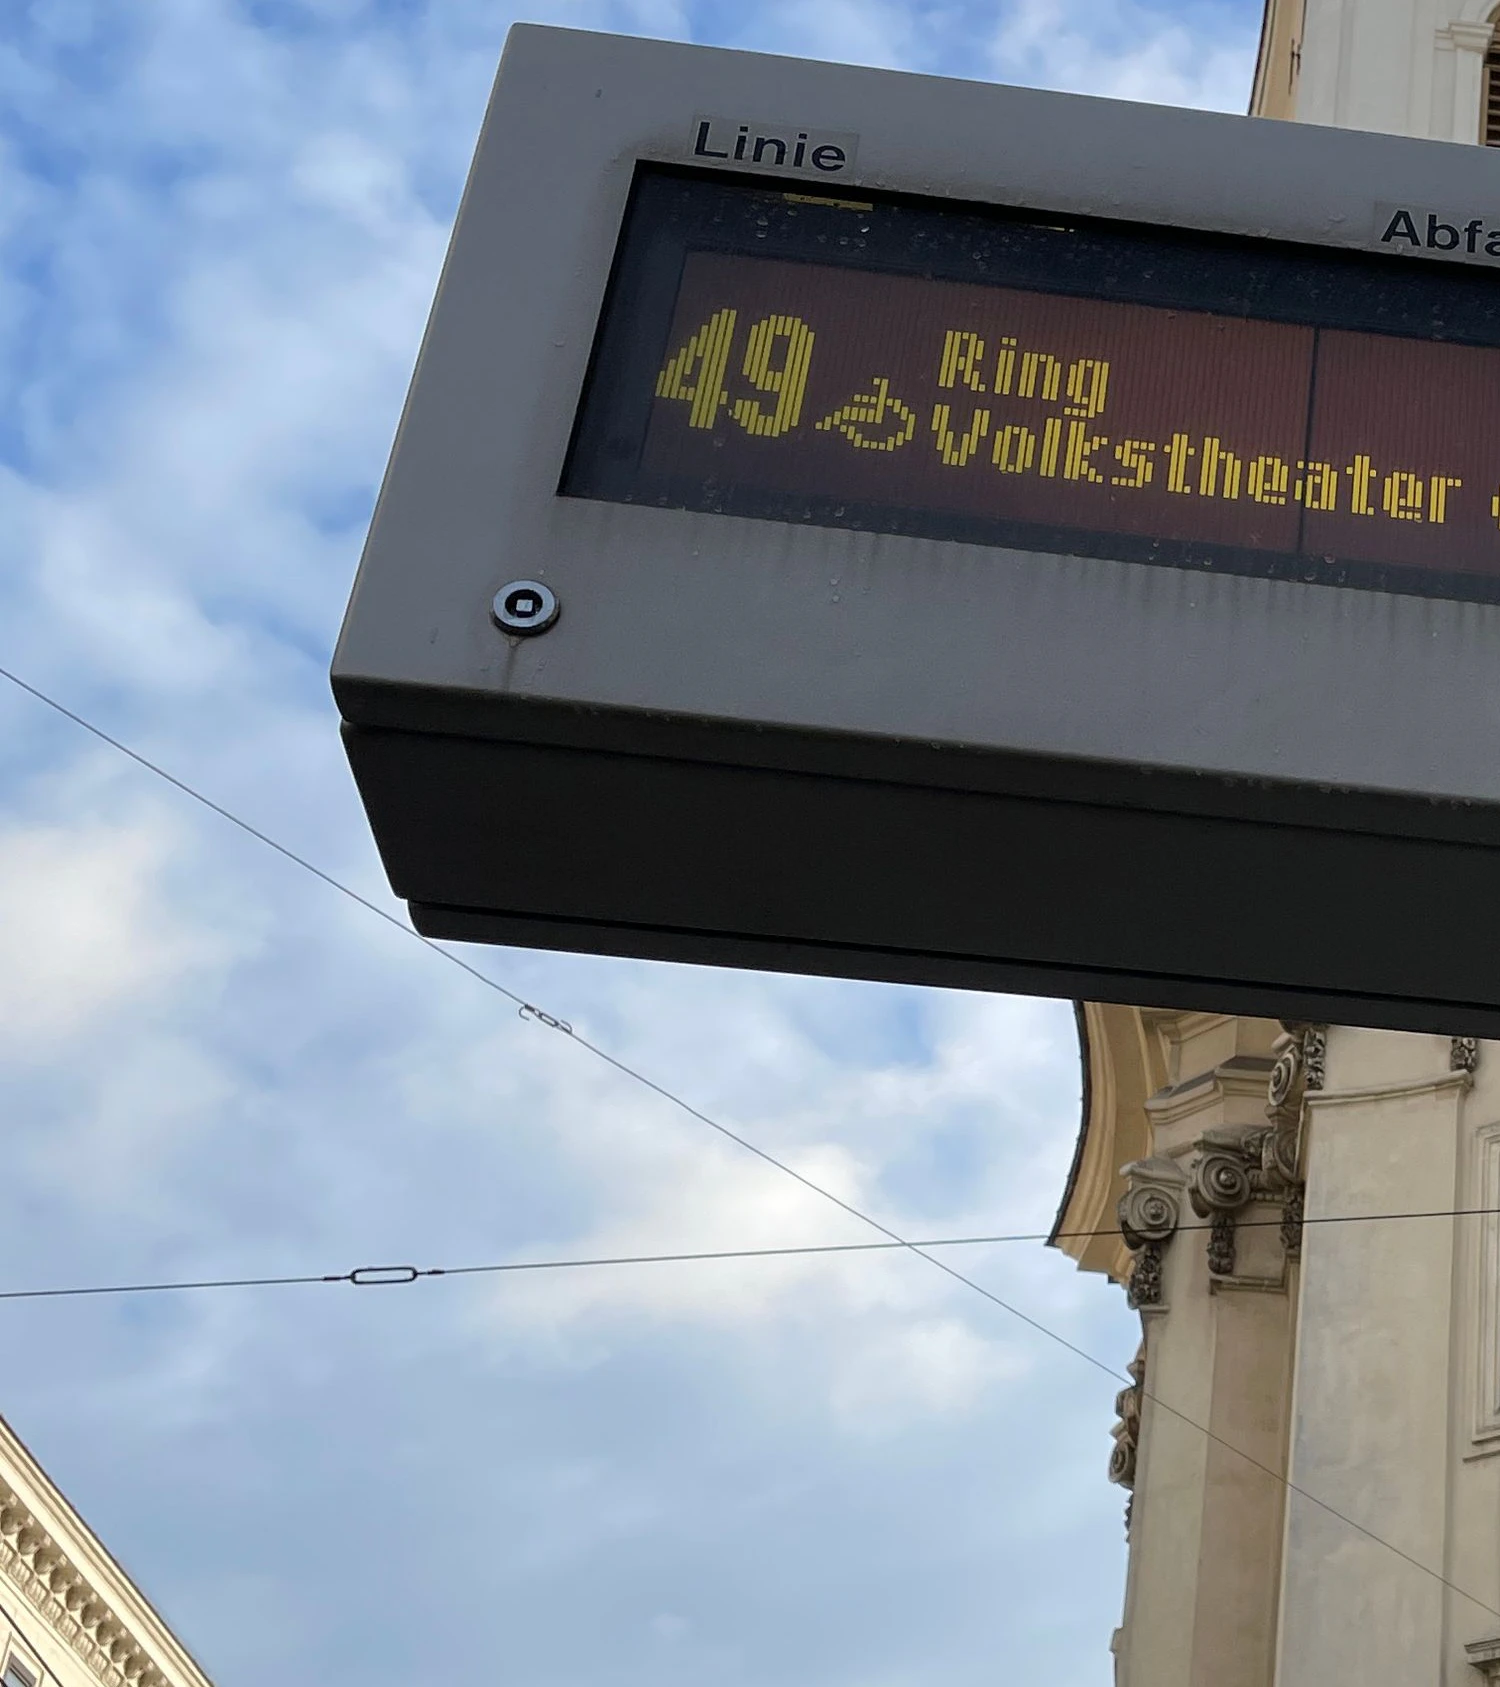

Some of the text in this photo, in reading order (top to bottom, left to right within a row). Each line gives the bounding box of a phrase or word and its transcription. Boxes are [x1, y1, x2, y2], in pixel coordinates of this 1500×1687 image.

[693, 120, 848, 173] Linie
[655, 308, 815, 437] 49
[937, 330, 1110, 419] Ring
[931, 403, 1462, 524] Volkstheater
